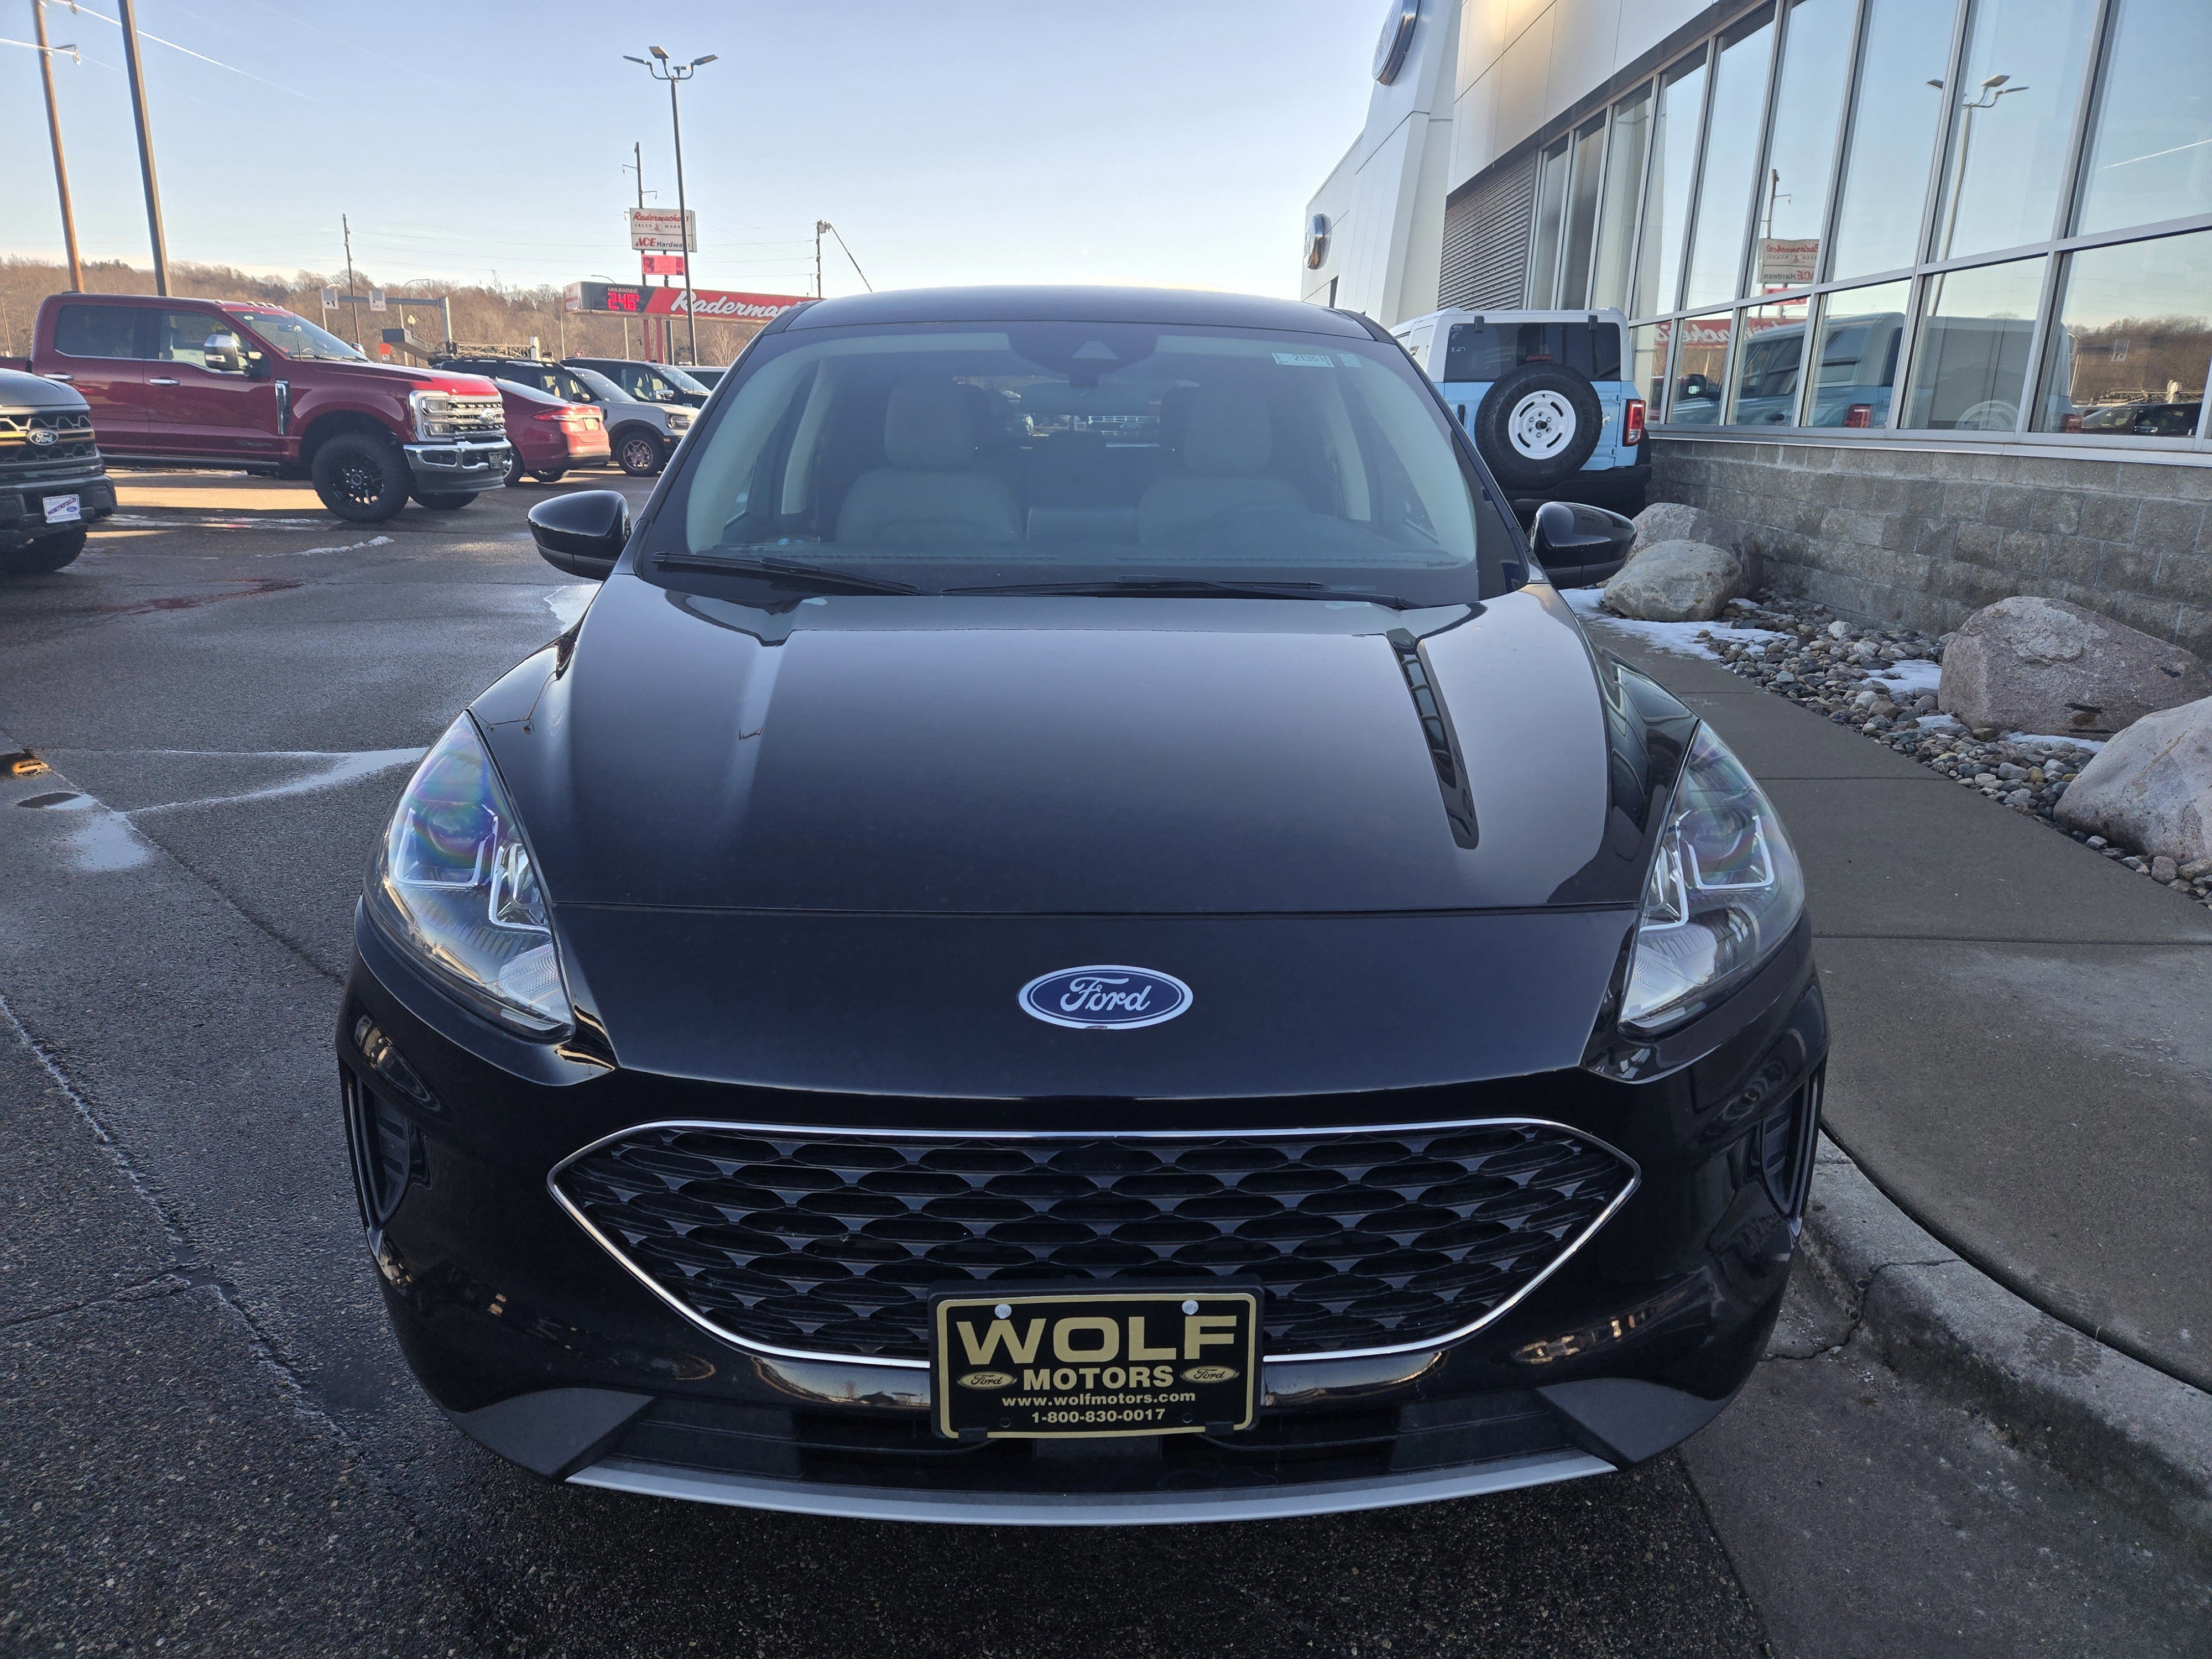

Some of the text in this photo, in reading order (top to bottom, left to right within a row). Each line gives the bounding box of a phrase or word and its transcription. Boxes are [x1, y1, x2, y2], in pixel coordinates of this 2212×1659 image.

[633, 212, 688, 222] Radermache
[635, 236, 656, 247] ACE
[36, 432, 53, 442] Ford
[48, 498, 76, 515] NORTHFIELD
[1060, 977, 1151, 1011] Ford
[956, 1316, 1237, 1365] WOLF
[971, 1375, 1003, 1387] Ford
[1024, 1366, 1173, 1390] MOTORS
[1193, 1369, 1225, 1380] Ford
[1002, 1392, 1195, 1406] www.wolfmotors.com
[1032, 1409, 1165, 1423] 1-800-830-0017
